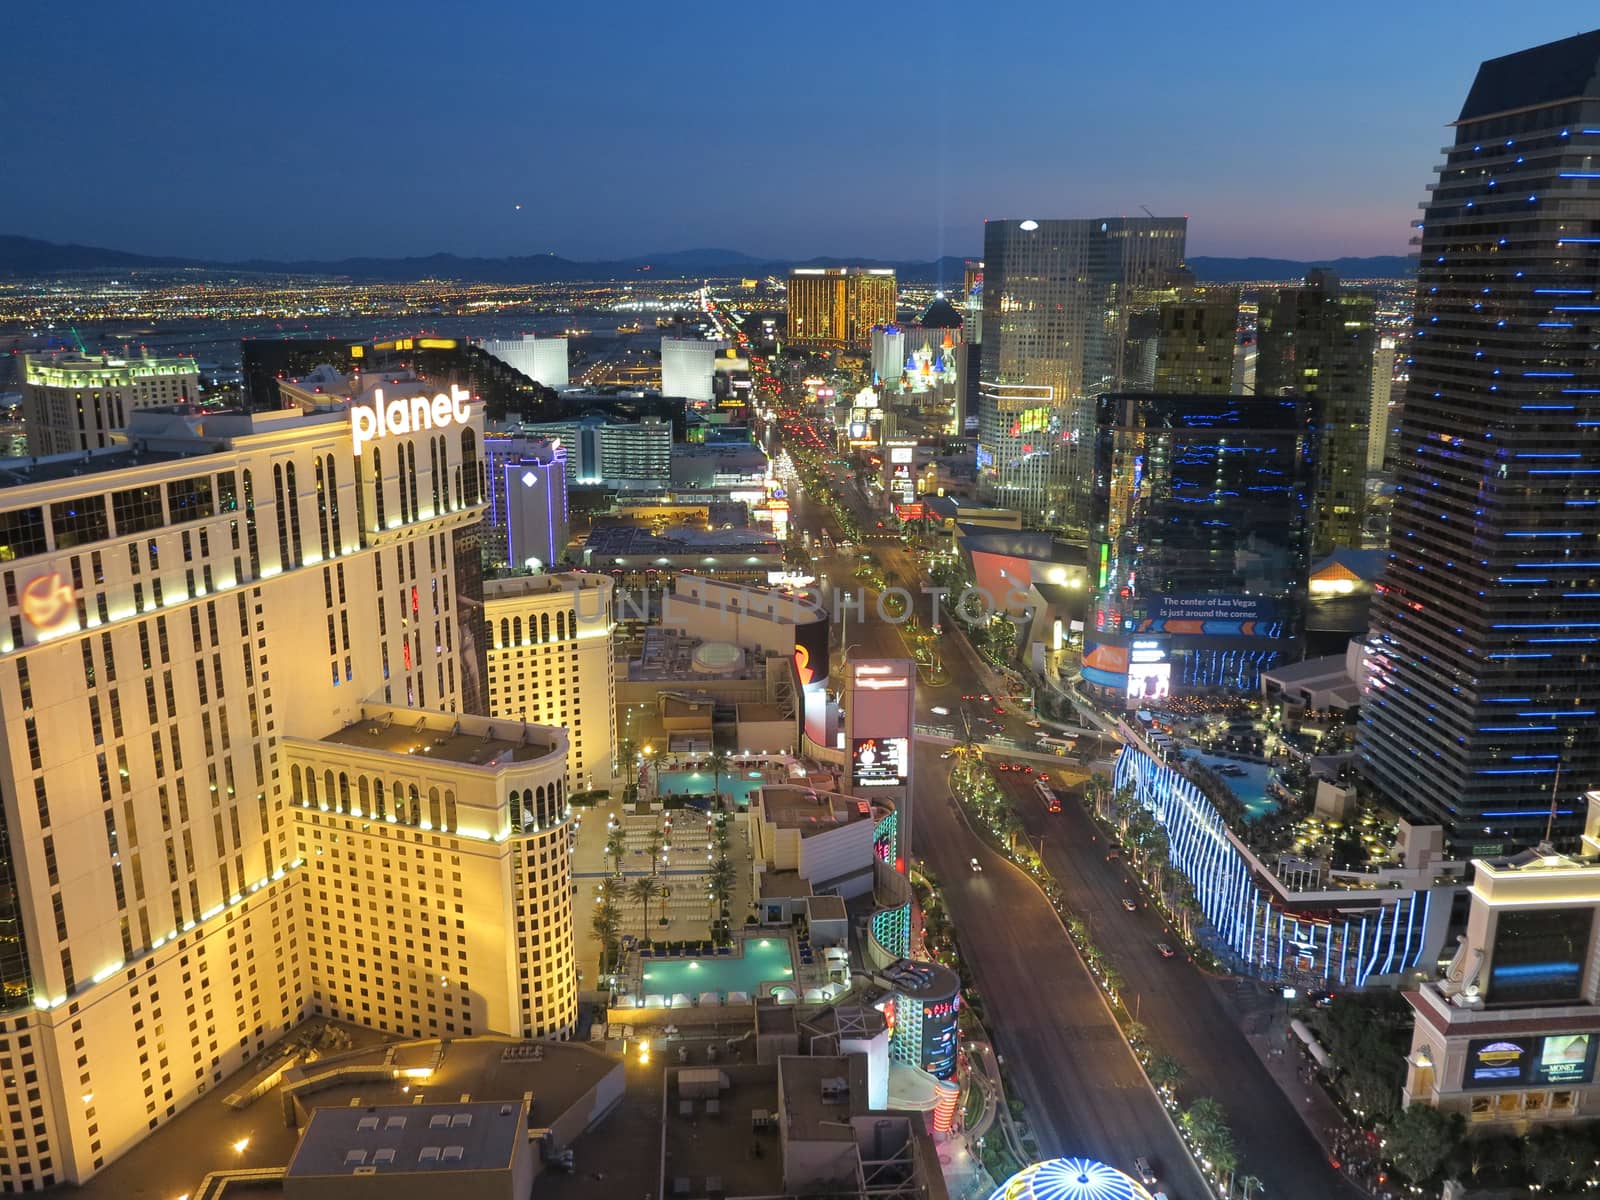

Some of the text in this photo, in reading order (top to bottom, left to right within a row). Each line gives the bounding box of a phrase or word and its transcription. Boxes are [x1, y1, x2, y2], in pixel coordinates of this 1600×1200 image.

[351, 384, 471, 456] planet
[1164, 597, 1257, 608] The center of Las Vegas
[1159, 608, 1258, 618] is just around the corner.
